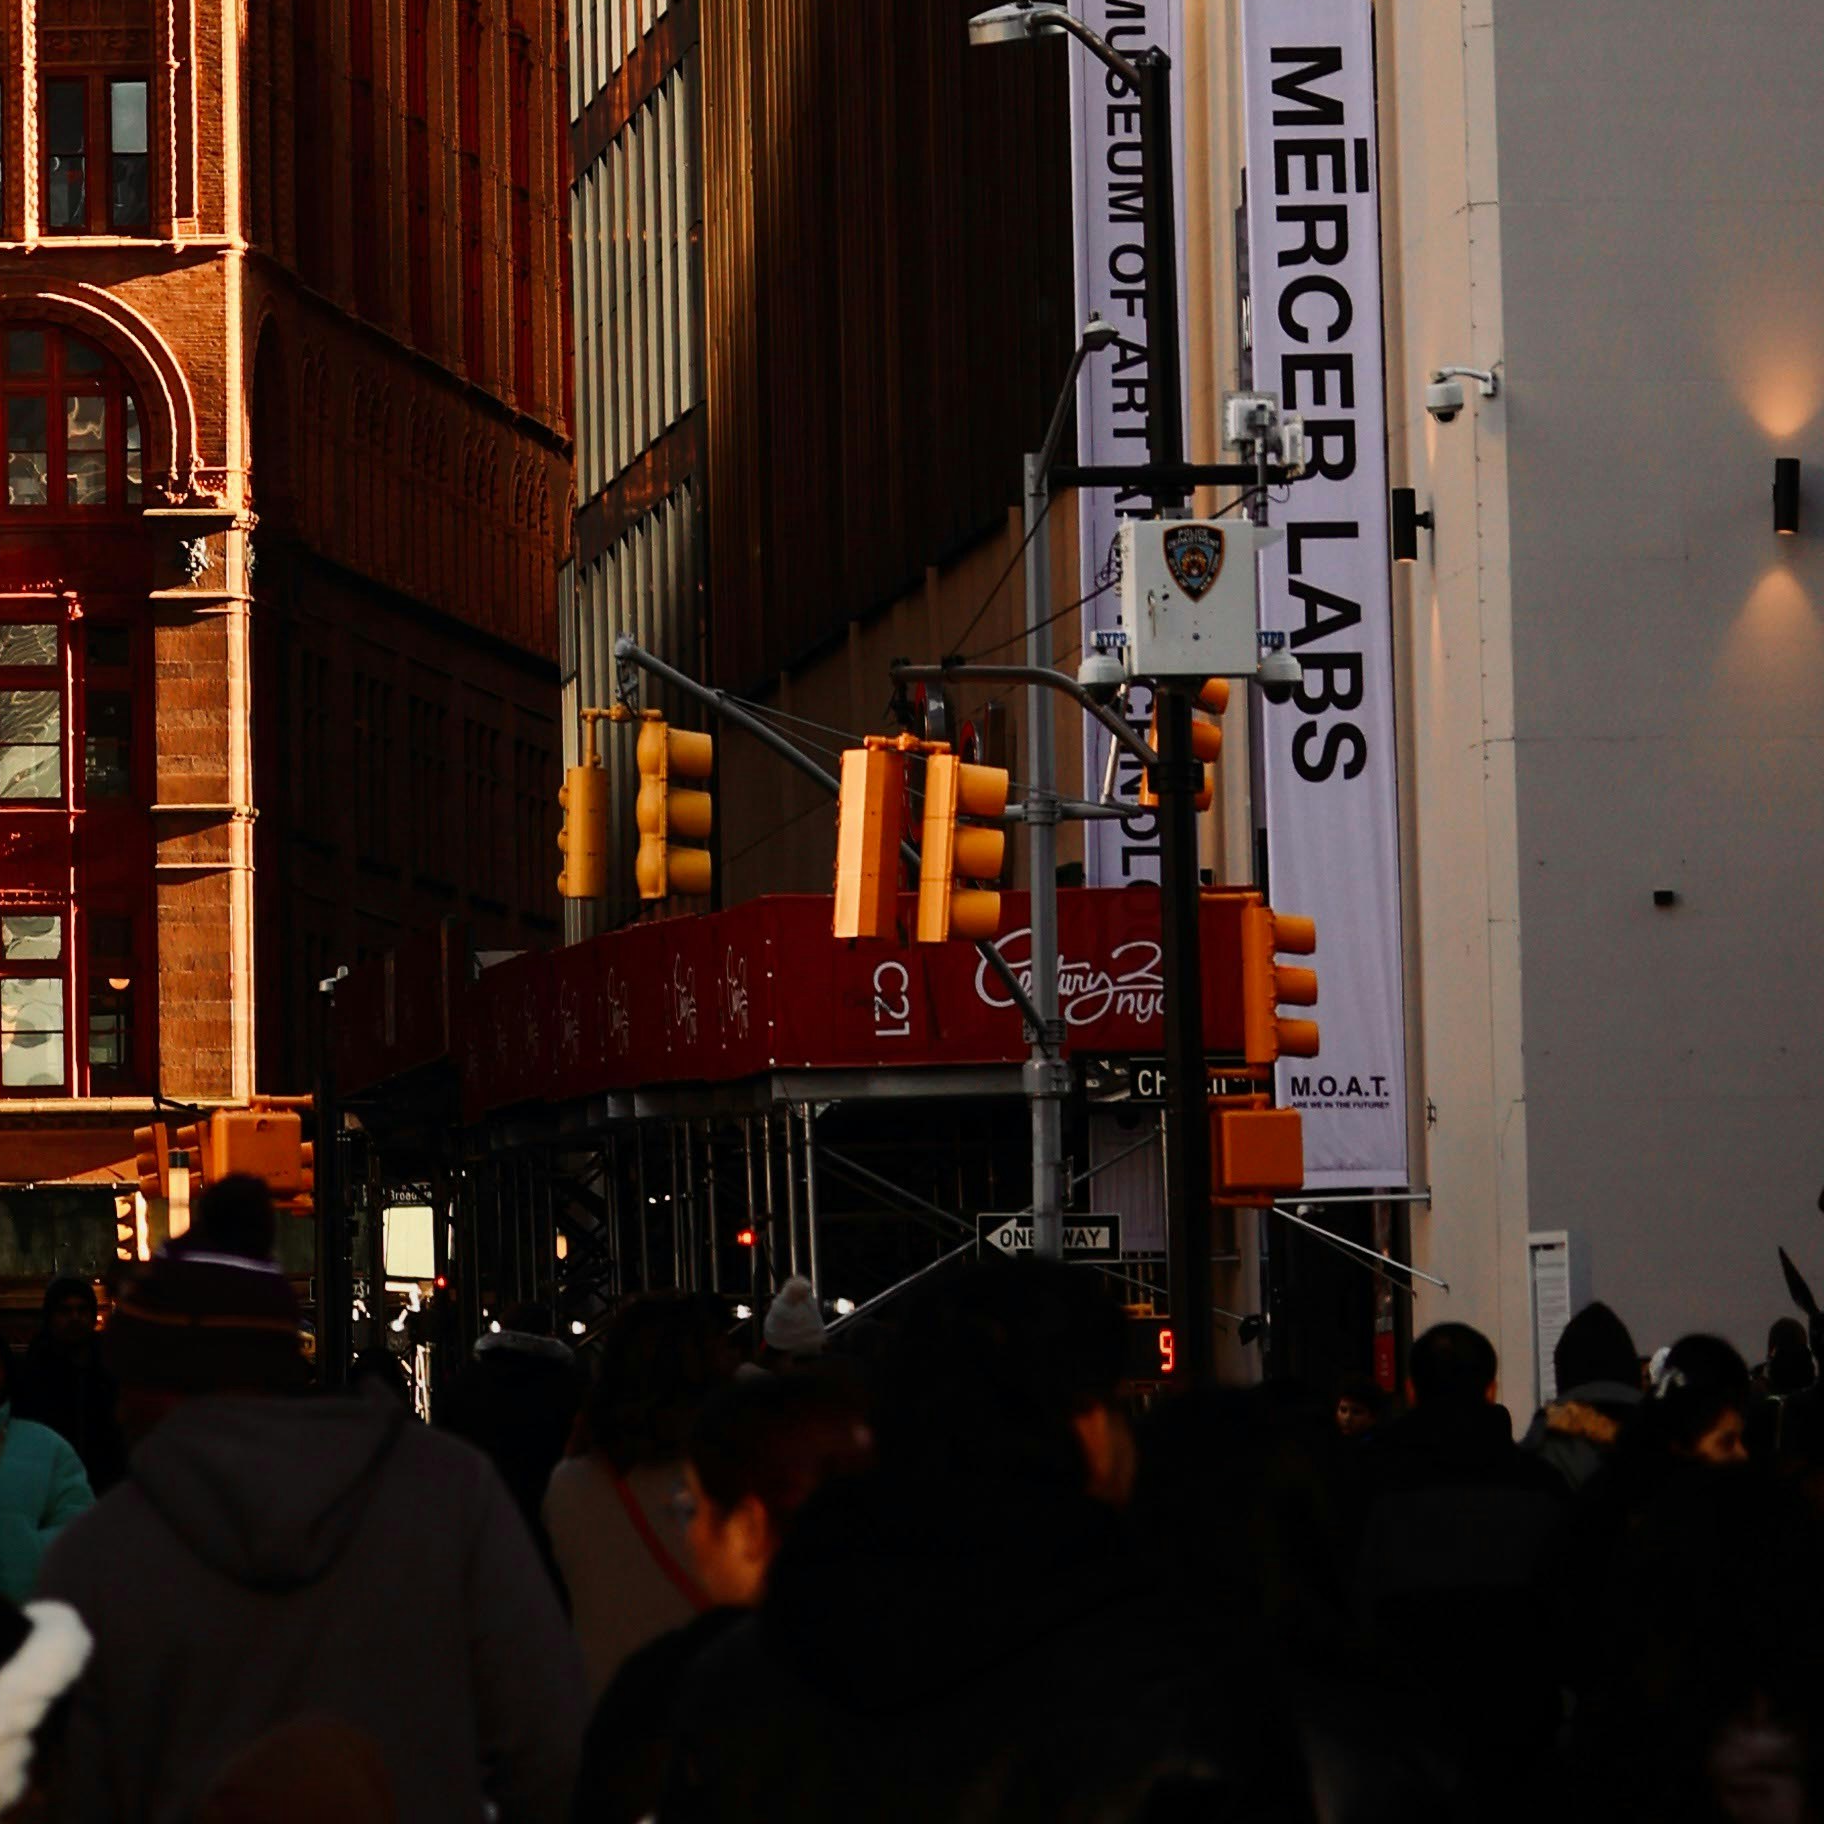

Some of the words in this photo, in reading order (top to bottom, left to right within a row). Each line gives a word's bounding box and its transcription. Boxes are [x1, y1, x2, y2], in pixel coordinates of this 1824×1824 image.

[1096, 633, 1127, 647] NYPD
[1286, 521, 1367, 783] LABS
[873, 961, 911, 1036] C21
[1290, 1075, 1389, 1097] M.O.A.T.
[1292, 1101, 1308, 1109] ARE
[1310, 1101, 1322, 1109] WE
[1336, 1101, 1351, 1109] THE
